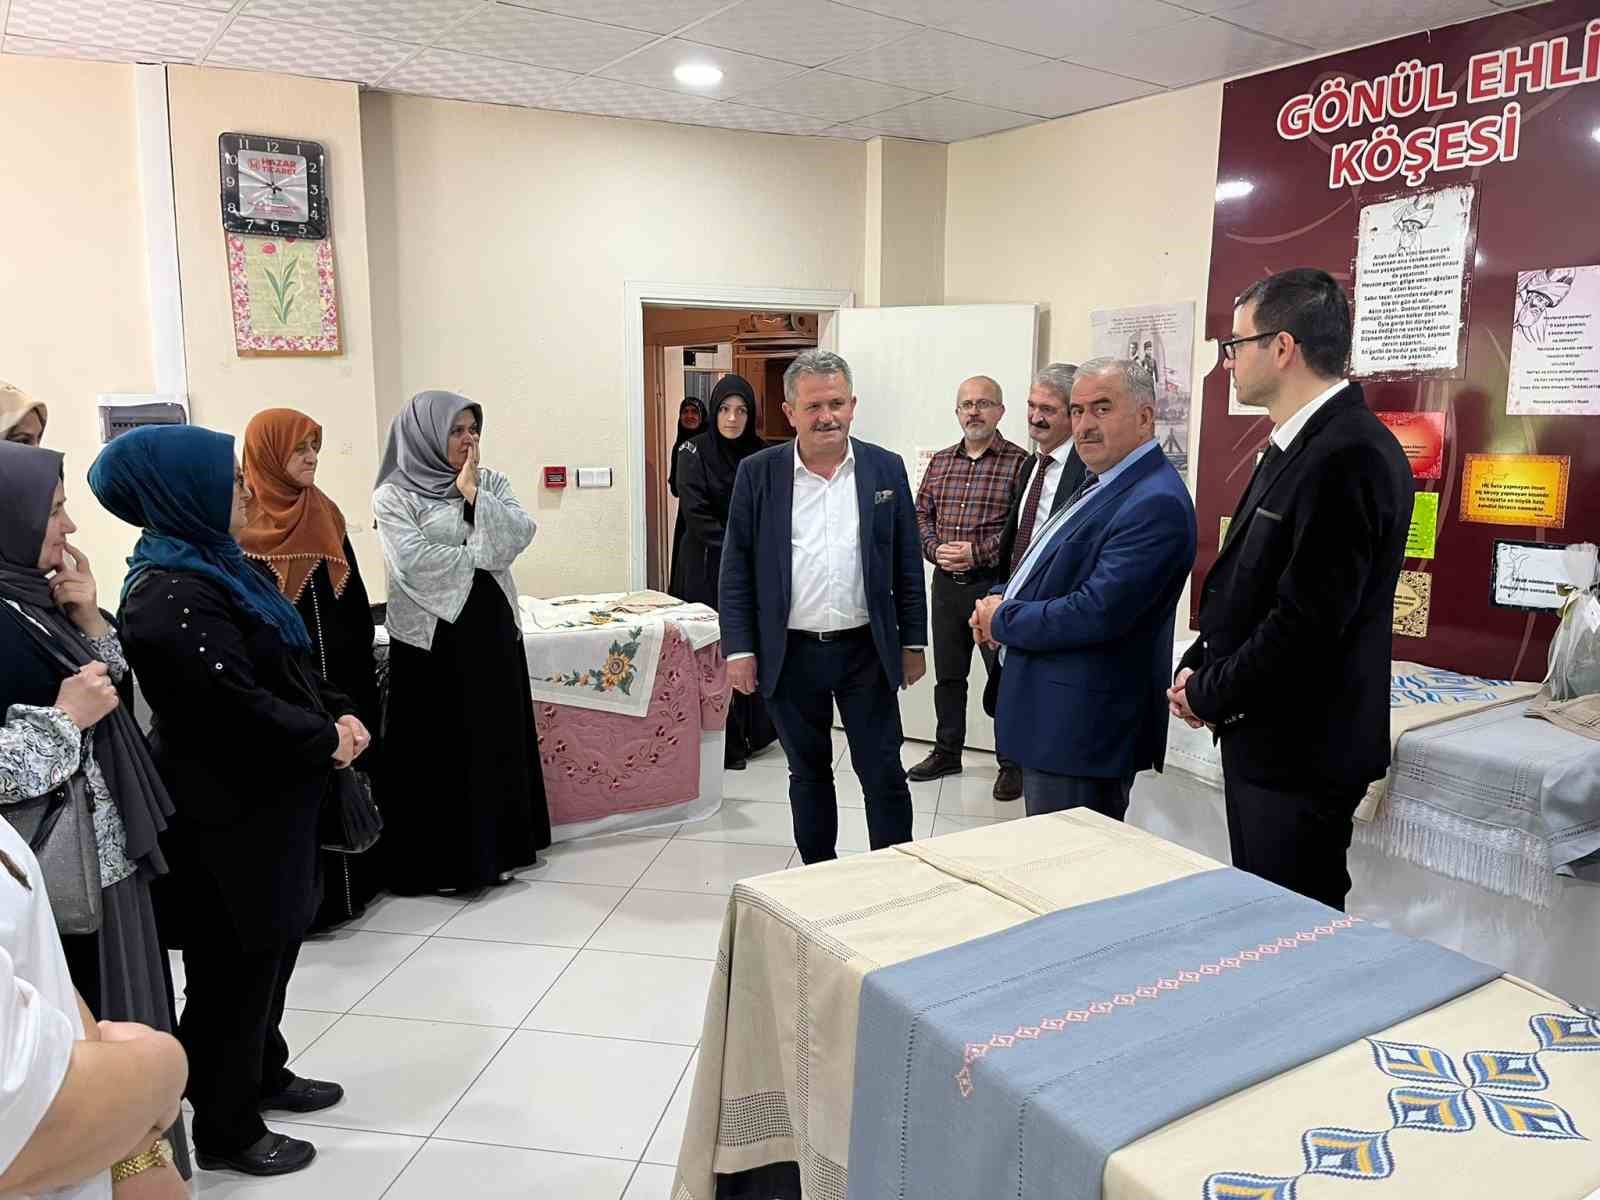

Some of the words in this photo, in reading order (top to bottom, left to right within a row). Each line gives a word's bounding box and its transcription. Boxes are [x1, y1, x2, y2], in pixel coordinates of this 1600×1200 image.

[1277, 59, 1457, 140] GÖNÜL
[1467, 19, 1600, 103] EHLİ
[239, 138, 249, 150] 11
[266, 141, 280, 153] 12
[1329, 102, 1521, 189] KÖŞESİ
[309, 162, 318, 174] 2
[226, 176, 236, 188] 9
[310, 184, 319, 195] 3
[310, 209, 319, 220] 4
[246, 219, 254, 230] 7
[271, 220, 280, 232] 6
[298, 223, 307, 234] 5
